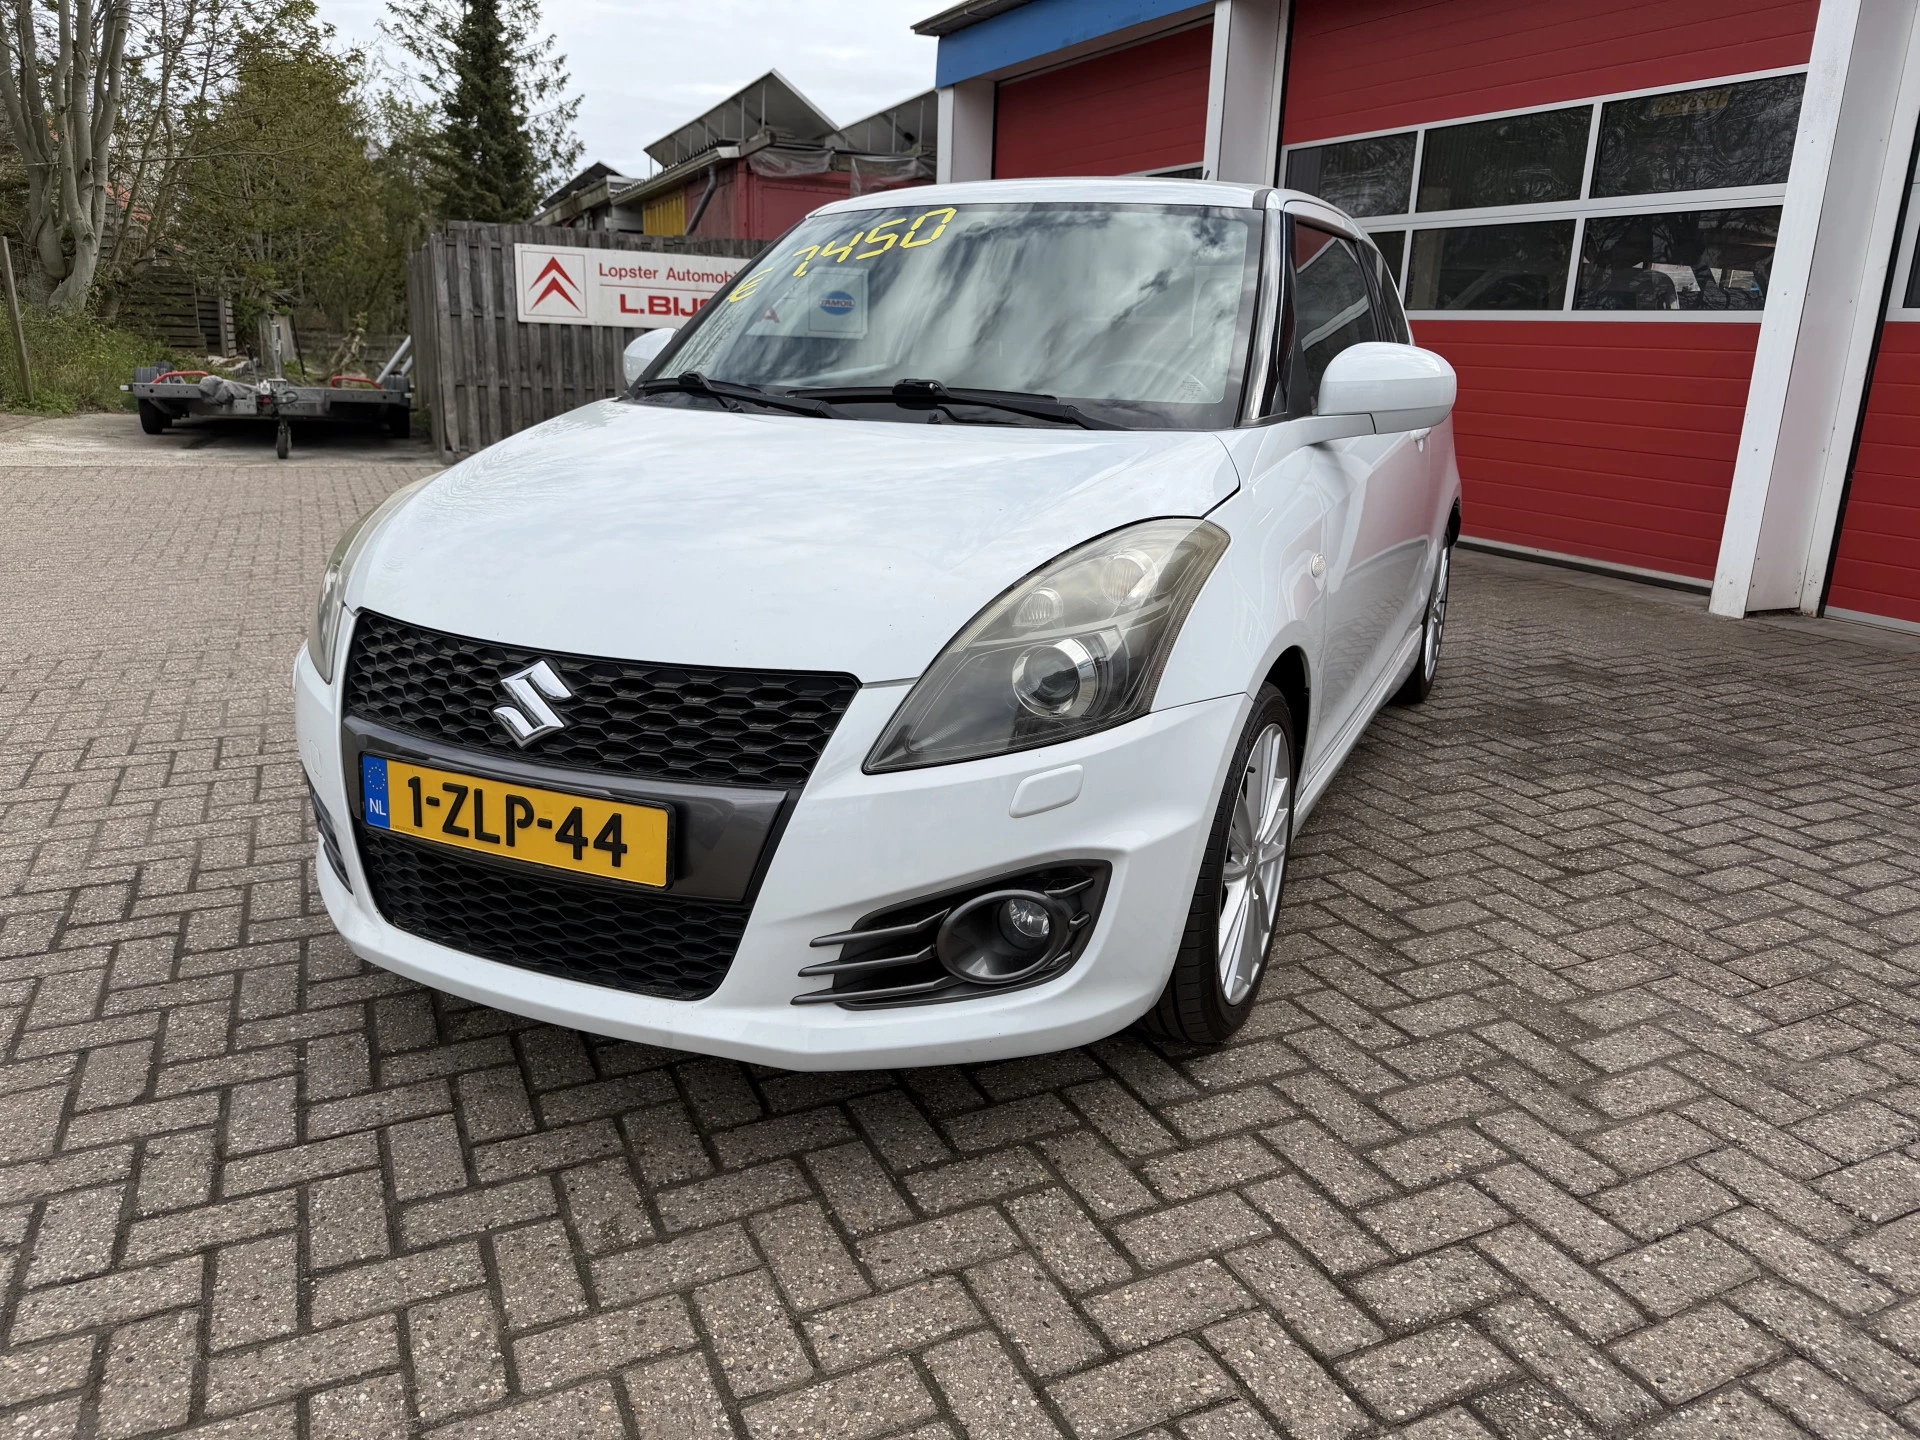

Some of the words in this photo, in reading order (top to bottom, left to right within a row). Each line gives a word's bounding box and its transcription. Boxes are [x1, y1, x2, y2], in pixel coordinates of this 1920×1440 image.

[598, 262, 659, 280] Lopster
[665, 266, 737, 285] Automob
[726, 267, 774, 303] €
[821, 298, 855, 308] TAMOIL
[369, 797, 387, 816] NL
[407, 775, 628, 868] 1-ZLP-44
